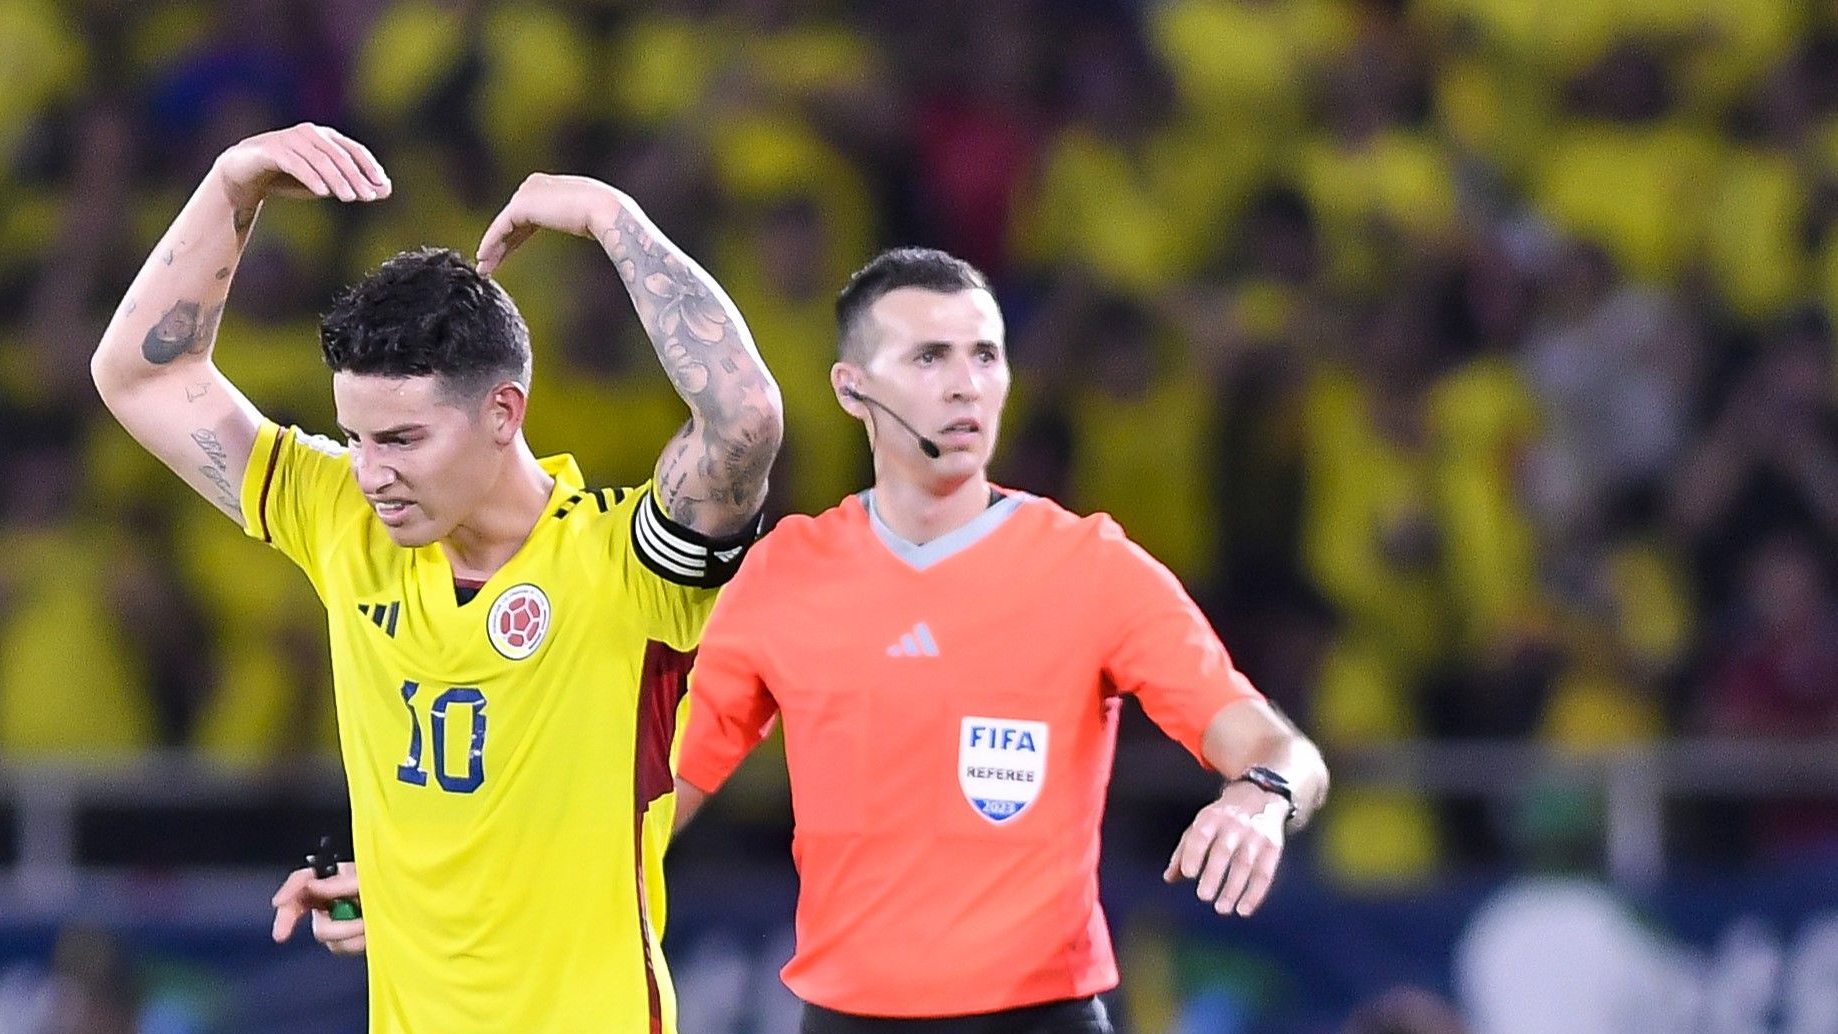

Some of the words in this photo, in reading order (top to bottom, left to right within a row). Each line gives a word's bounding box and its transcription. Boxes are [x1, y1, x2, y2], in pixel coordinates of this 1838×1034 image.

[396, 679, 488, 794] 10
[970, 725, 1036, 753] FIFA
[966, 765, 1035, 783] REFEREE
